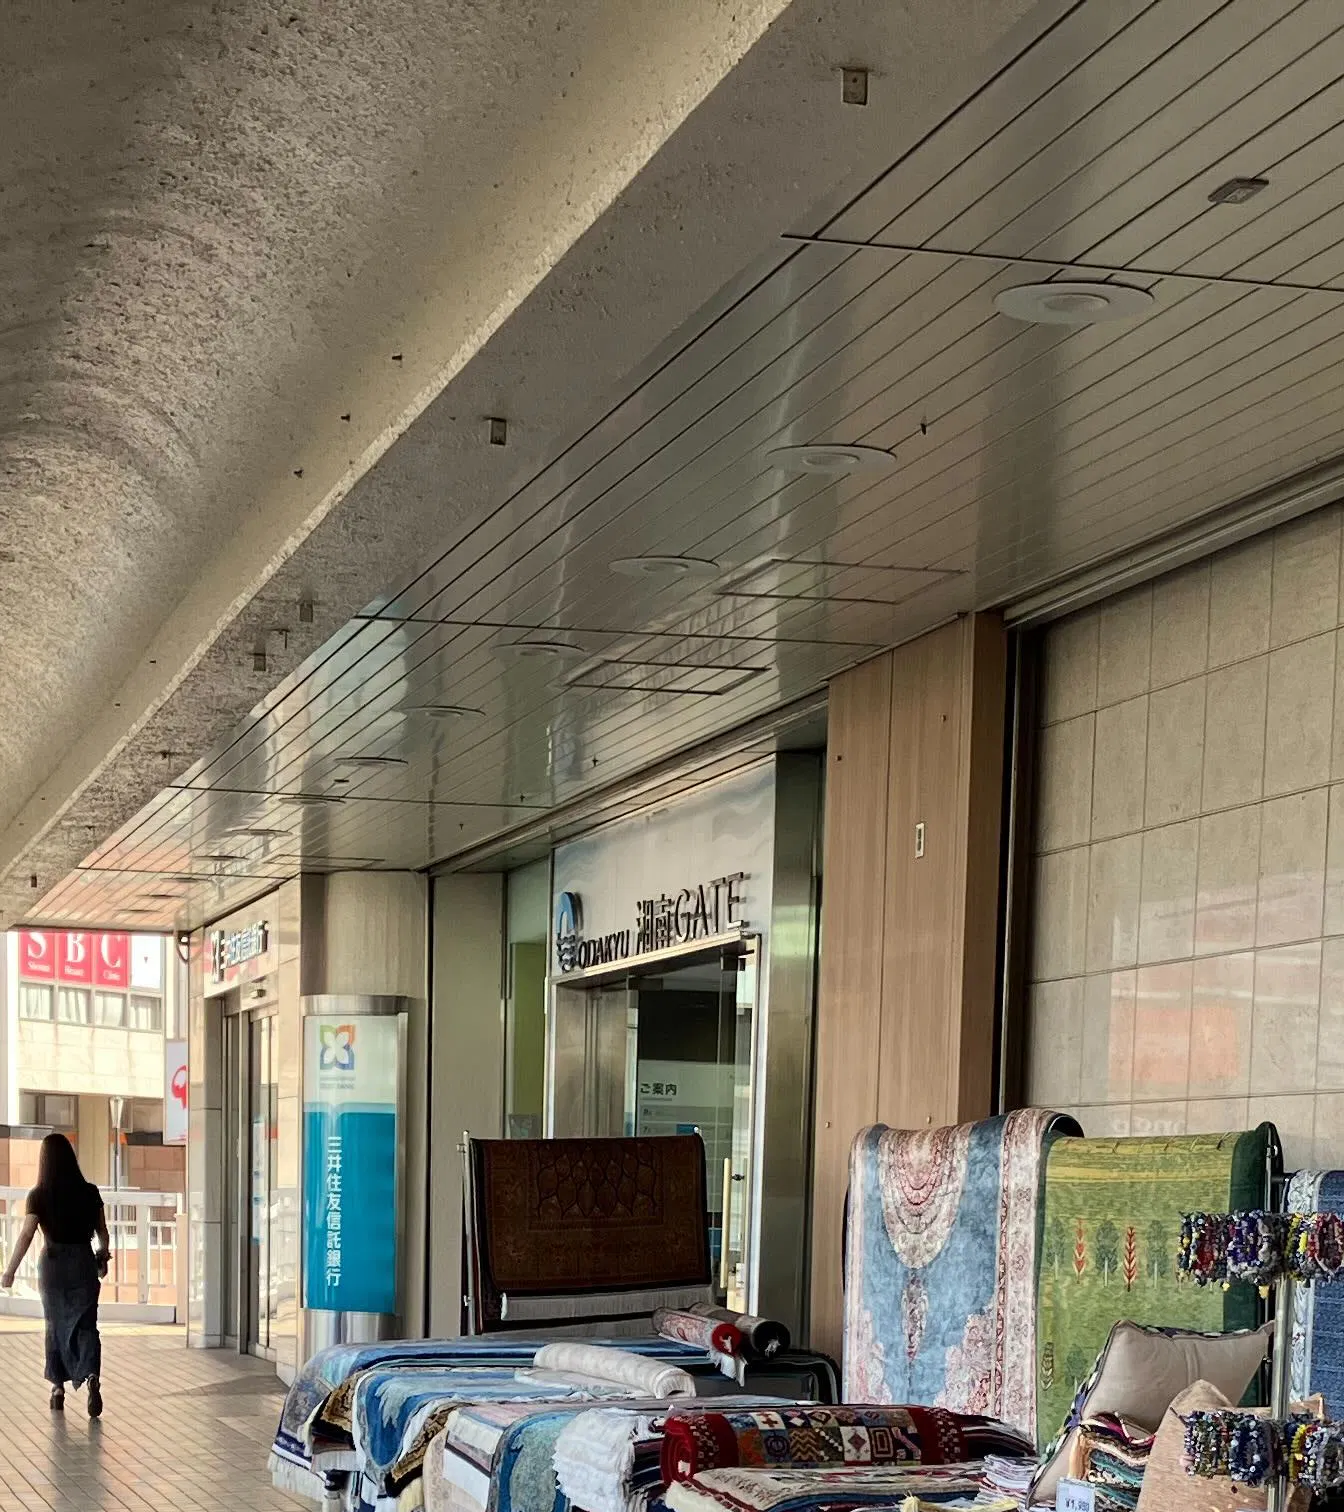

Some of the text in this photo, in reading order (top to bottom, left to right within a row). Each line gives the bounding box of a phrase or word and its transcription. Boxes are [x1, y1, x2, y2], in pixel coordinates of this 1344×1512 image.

[578, 872, 745, 969] ODAKYU 湘南GATE
[640, 1083, 677, 1095] ご案内
[326, 1136, 342, 1287] 三井住友信託銀行
